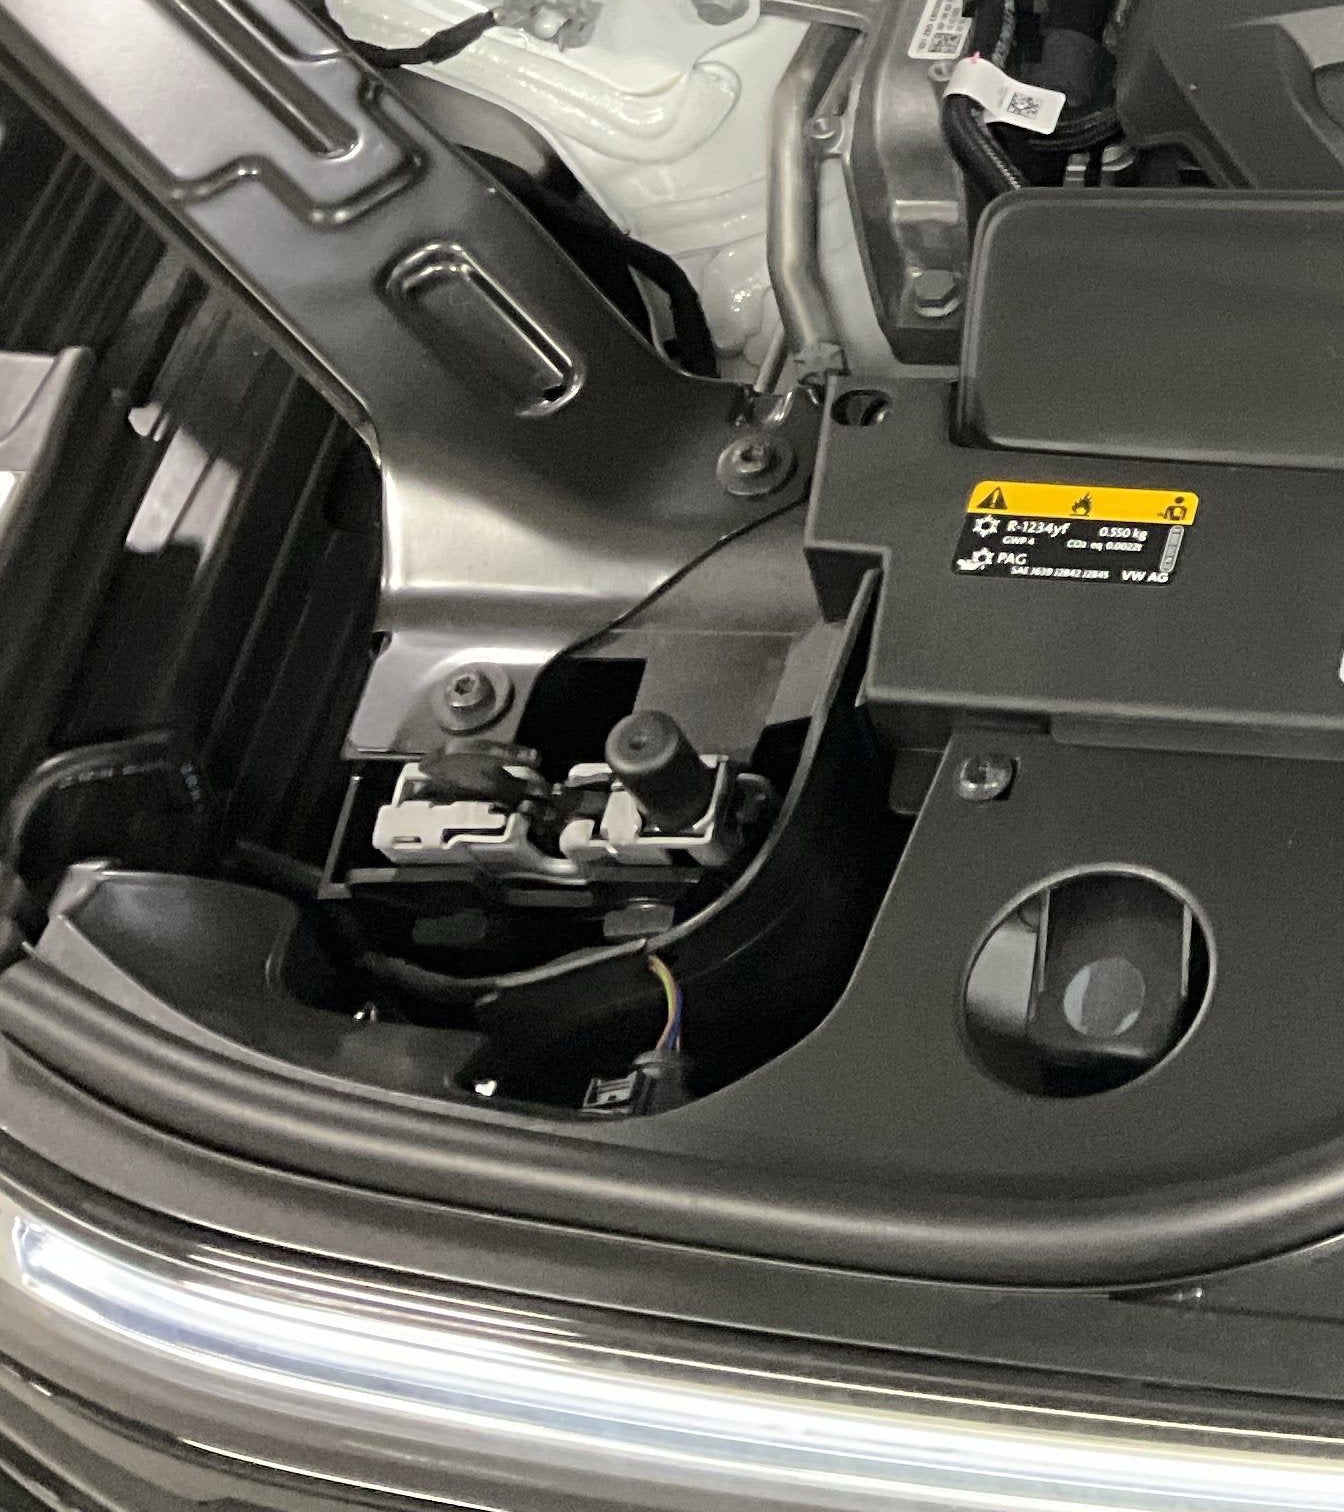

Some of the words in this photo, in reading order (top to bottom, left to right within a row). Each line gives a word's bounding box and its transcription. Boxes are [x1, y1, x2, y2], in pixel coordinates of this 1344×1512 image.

[1007, 520, 1071, 538] R-1234yf
[1099, 526, 1131, 538] 0.550
[1132, 528, 1148, 542] kg
[997, 552, 1028, 565] PAG
[1122, 570, 1147, 582] VW
[1147, 571, 1169, 583] AG
